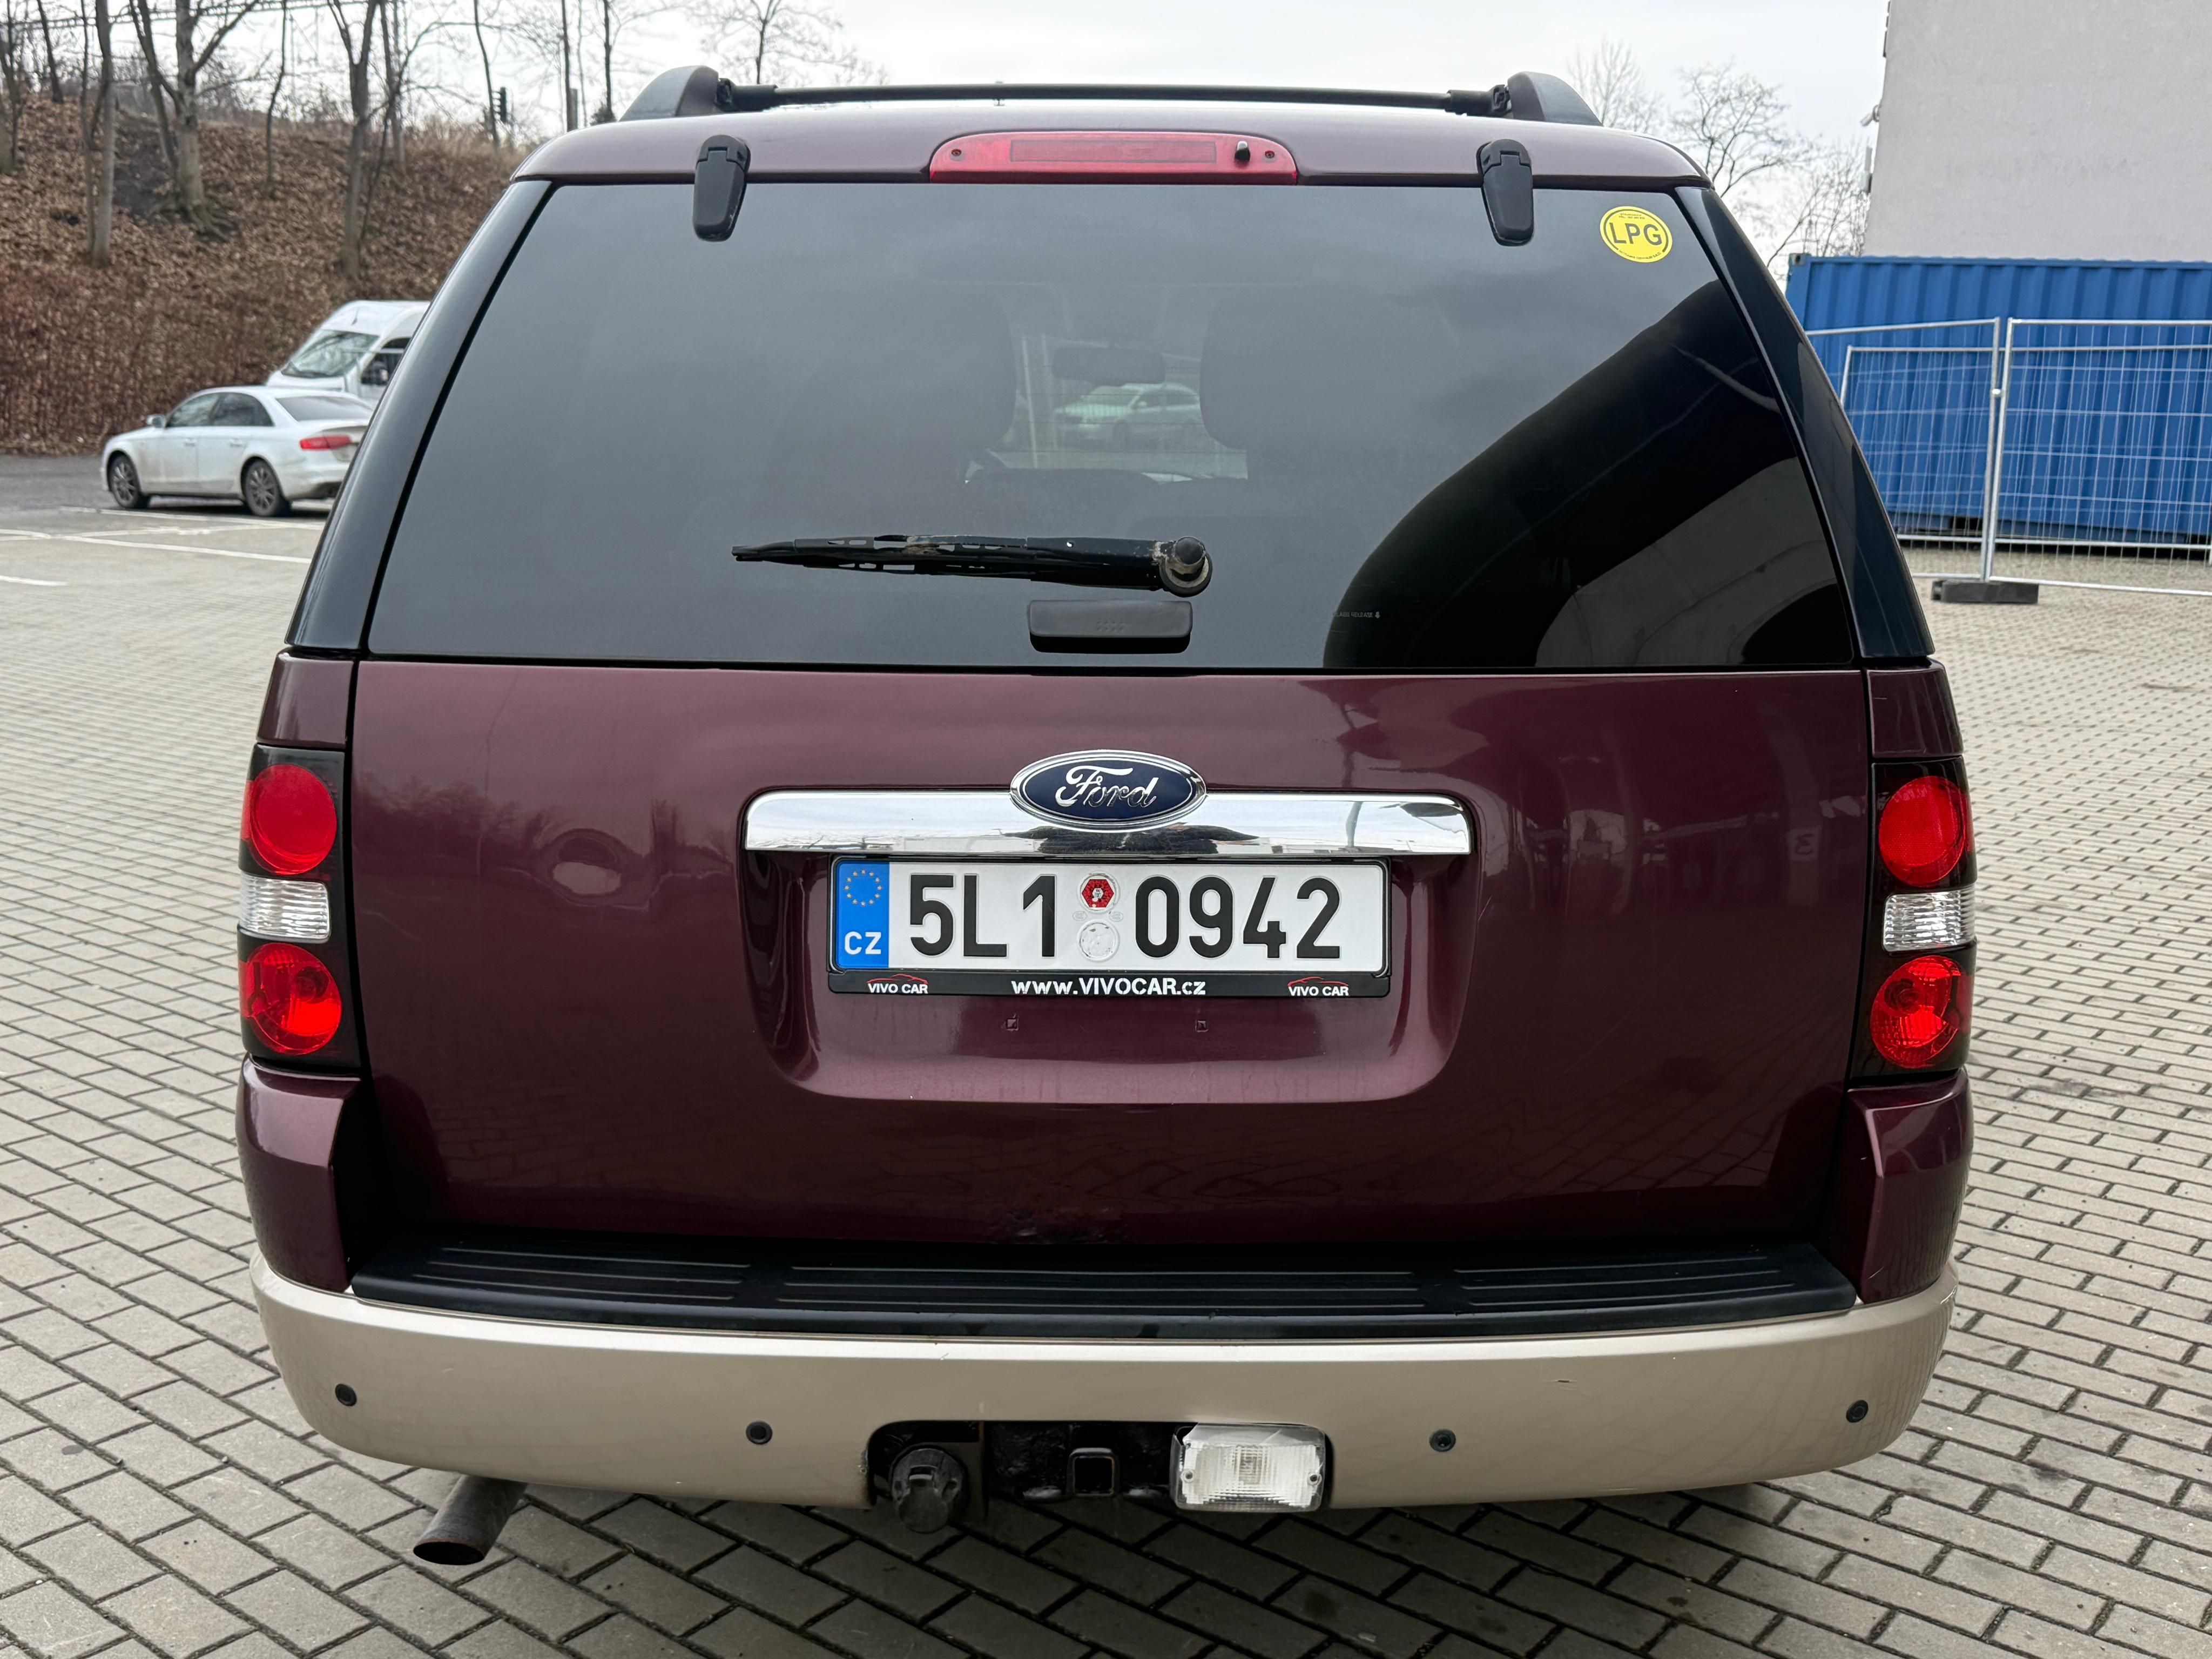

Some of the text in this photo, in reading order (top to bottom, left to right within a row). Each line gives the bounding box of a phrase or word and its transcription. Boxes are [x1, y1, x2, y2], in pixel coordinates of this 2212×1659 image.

[1609, 222, 1662, 246] LPG
[1055, 765, 1159, 807] Ford
[909, 874, 1340, 959] 5L1 0942
[844, 932, 882, 955] CZ
[867, 983, 928, 994] VIVO CAR
[1011, 977, 1206, 995] www.VIVOCAR.cz
[1288, 986, 1349, 996] VIVO CAR
